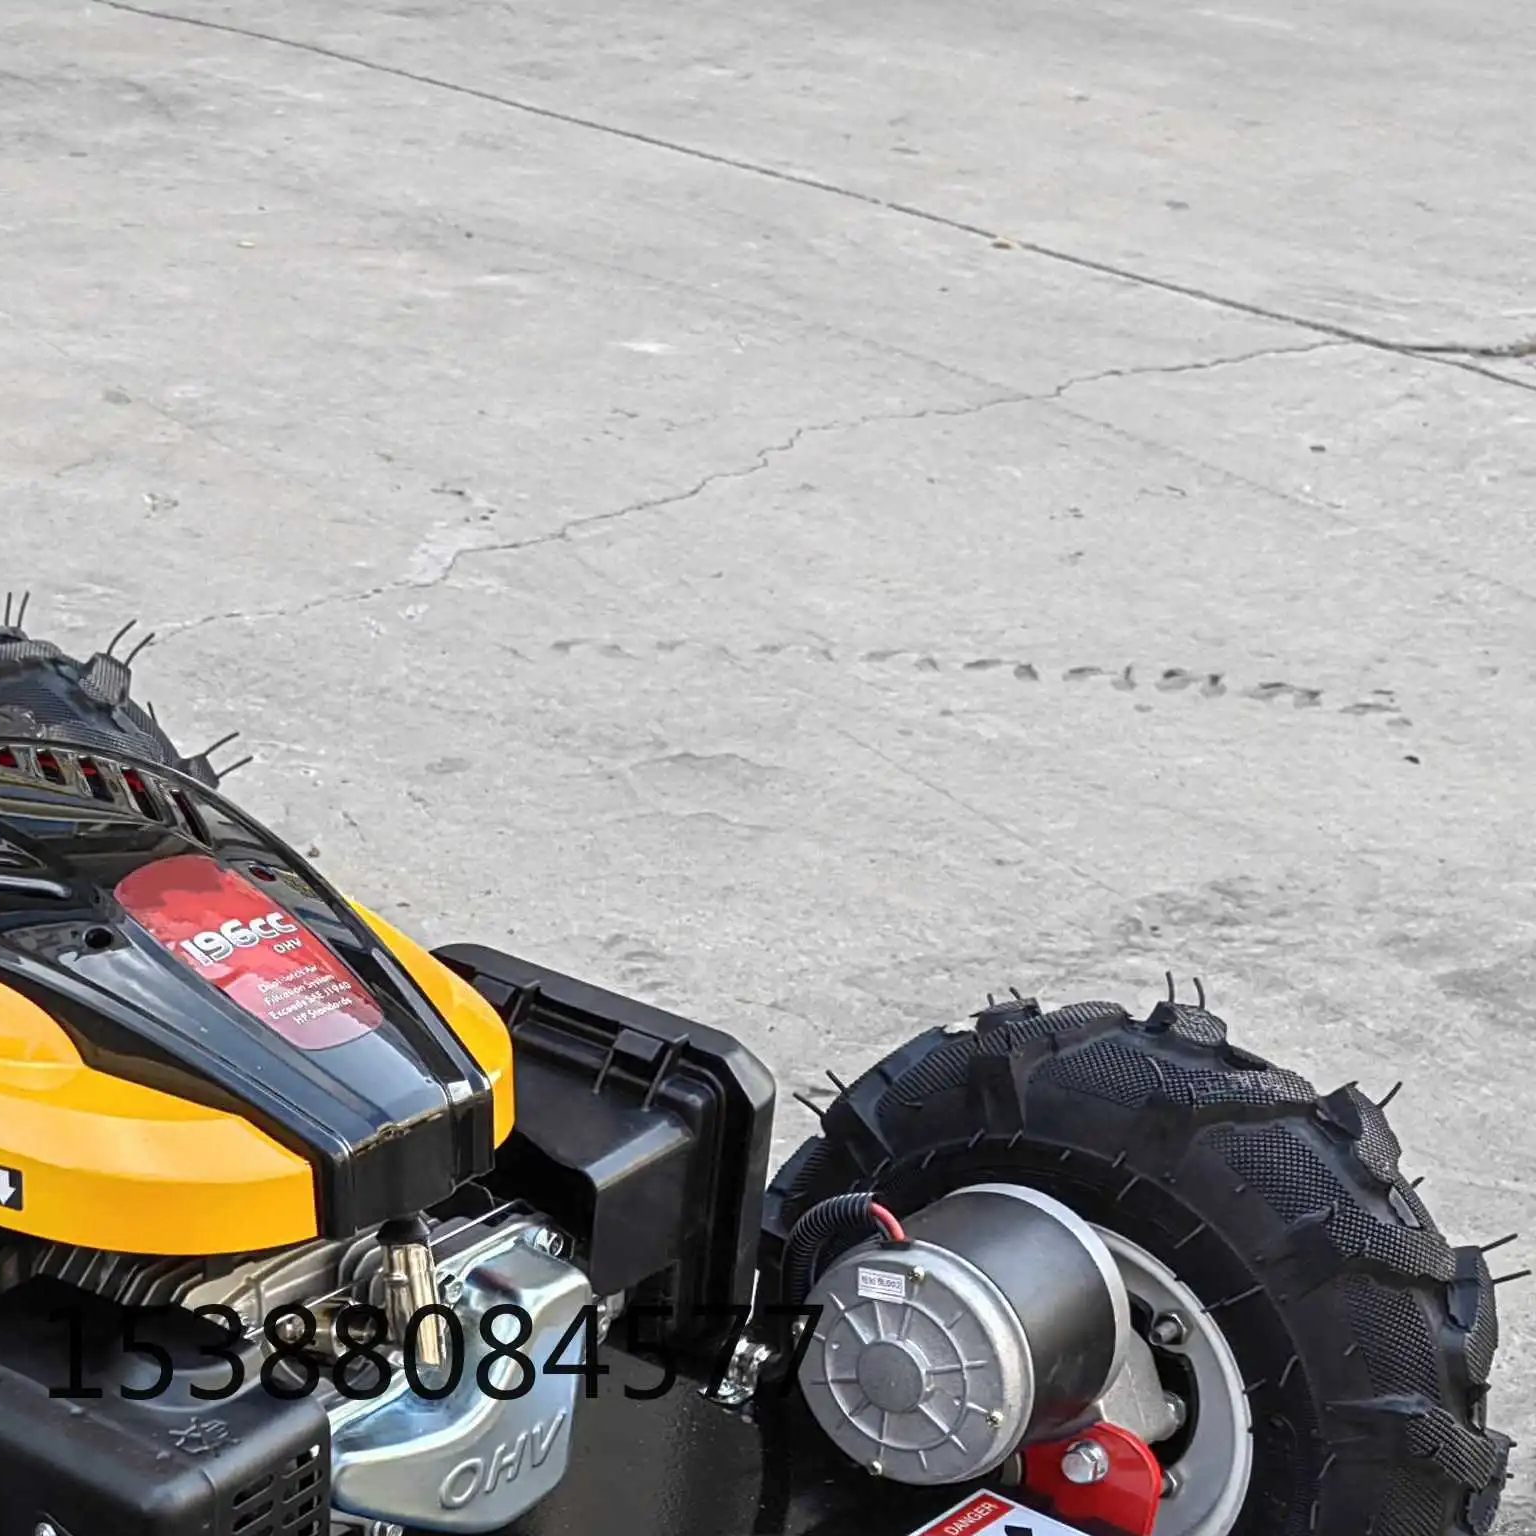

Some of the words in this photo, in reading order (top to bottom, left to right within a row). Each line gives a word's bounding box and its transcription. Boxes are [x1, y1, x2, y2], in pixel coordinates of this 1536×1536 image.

[180, 912, 298, 967] 196cc
[272, 937, 304, 954] OHV
[439, 1407, 568, 1511] OHV
[944, 1501, 1000, 1536] DANGER
